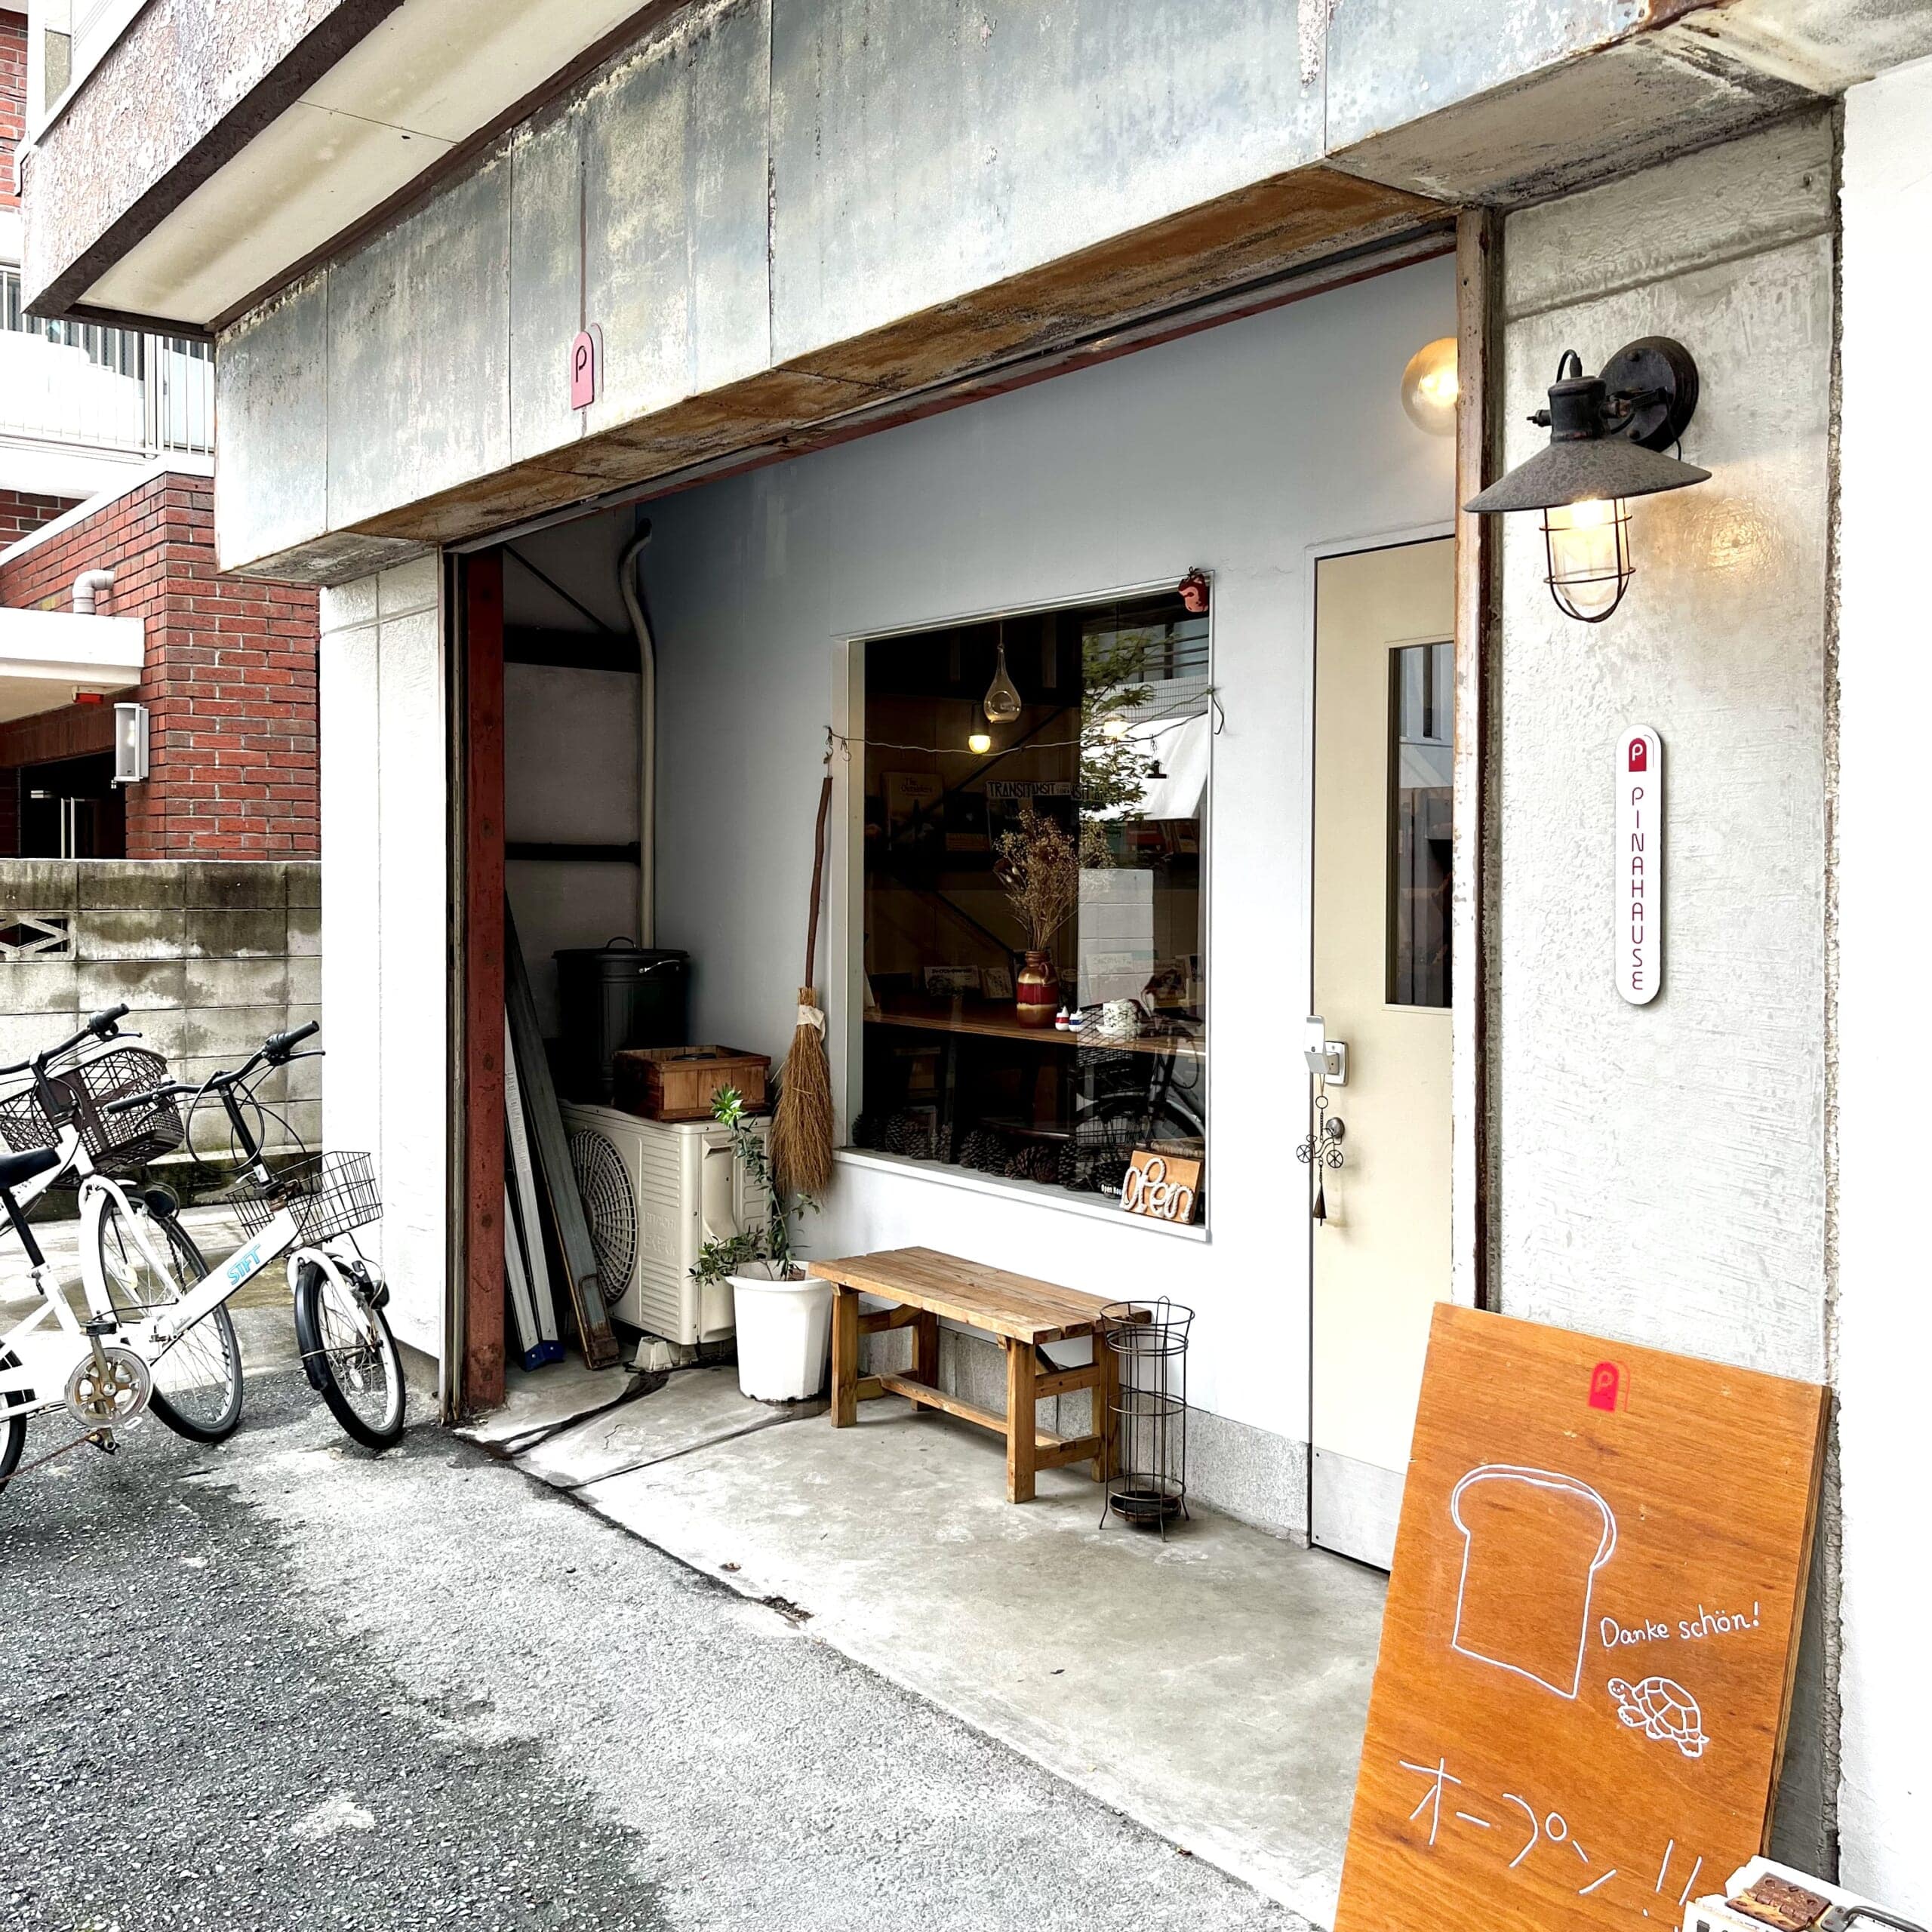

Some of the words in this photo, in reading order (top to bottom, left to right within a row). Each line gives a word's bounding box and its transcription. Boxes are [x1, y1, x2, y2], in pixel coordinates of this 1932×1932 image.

[575, 345, 587, 383] P
[1631, 743, 1644, 761] P
[987, 781, 1032, 798] TRANSIT
[1631, 786, 1644, 991] PINAHAUSE
[1594, 1370, 1615, 1393] P
[1600, 1617, 1670, 1648] Danke
[1678, 1600, 1761, 1640] schön!
